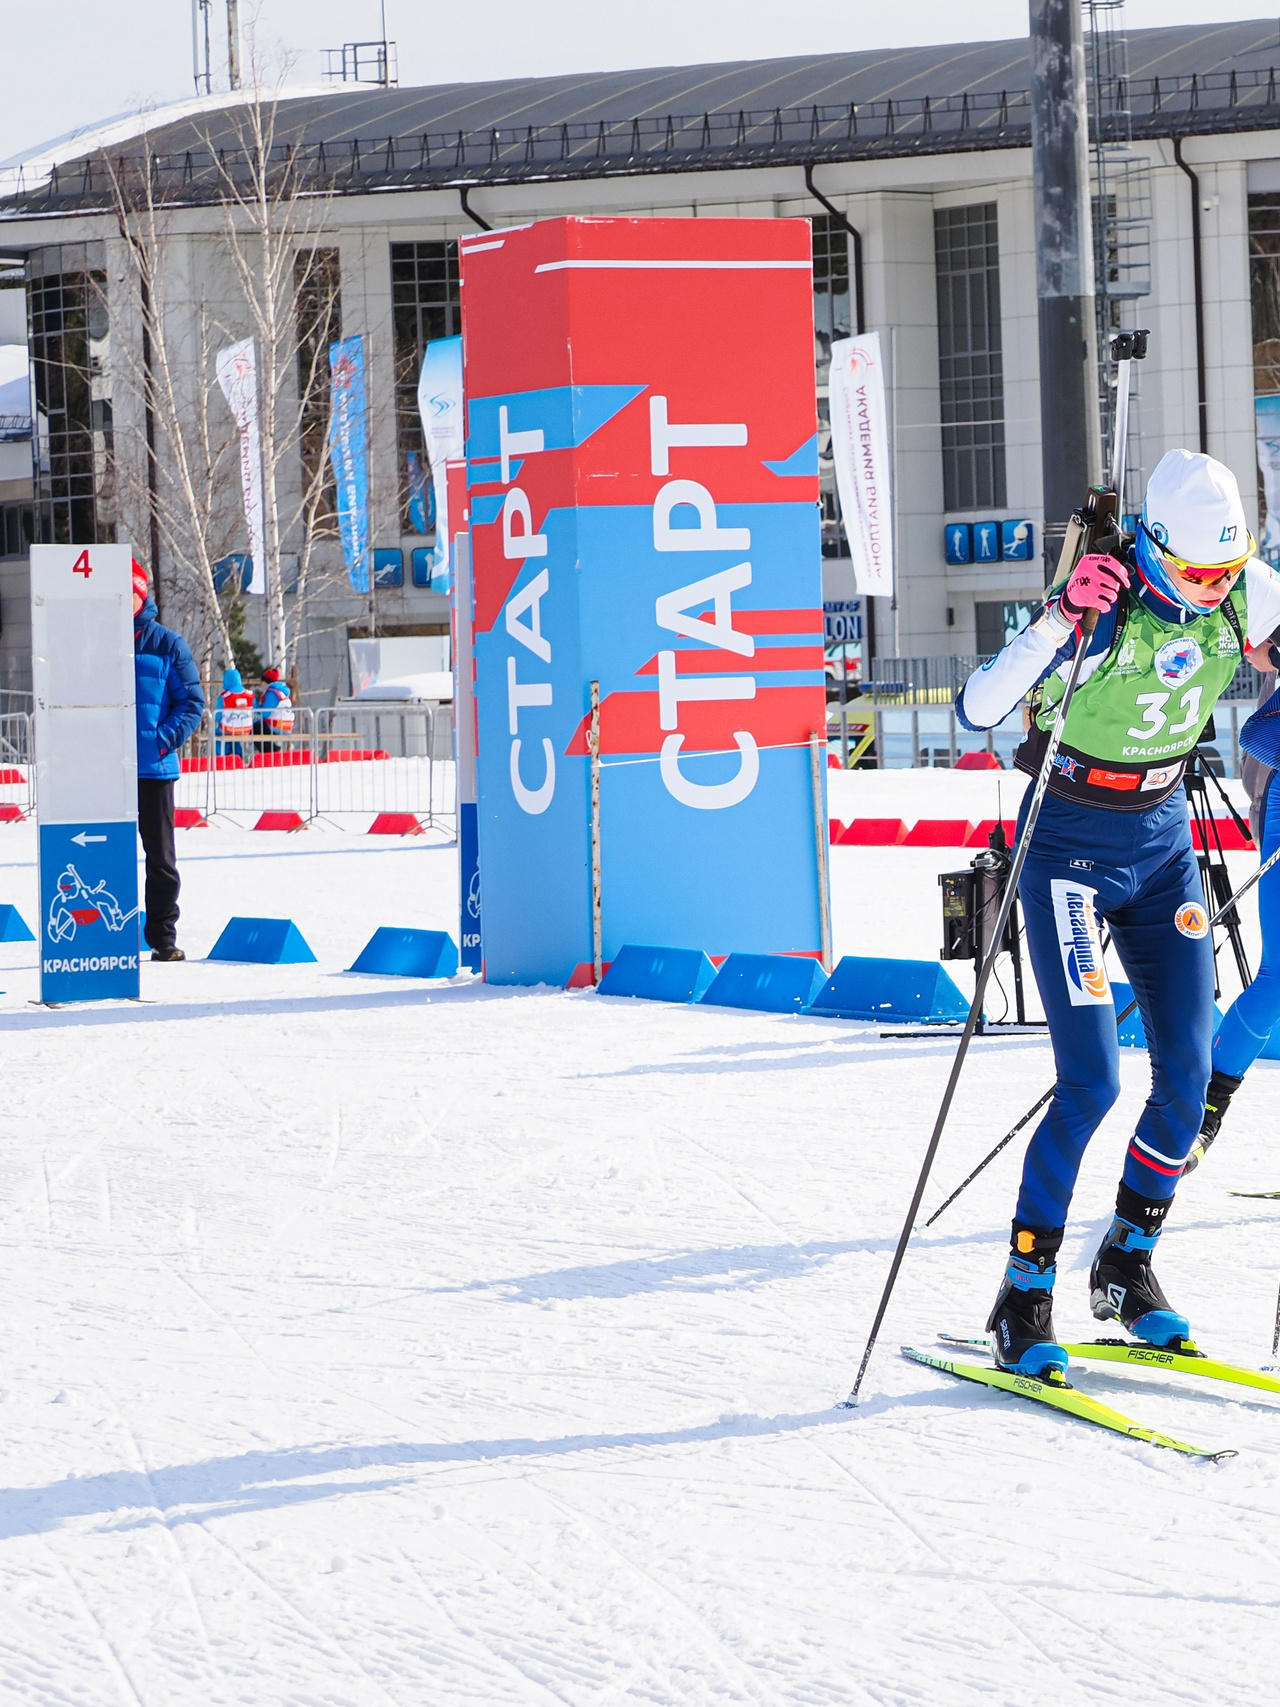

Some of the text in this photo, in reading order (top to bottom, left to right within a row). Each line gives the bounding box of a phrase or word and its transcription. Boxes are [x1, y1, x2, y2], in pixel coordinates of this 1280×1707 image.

[72, 549, 93, 579] 4
[499, 404, 556, 816] СТАРТ
[648, 394, 760, 811] СТАРТ
[1126, 685, 1204, 741] 31
[1121, 734, 1196, 757] КРАСНОЯРСК
[42, 953, 139, 974] КРАСНОЯРСК
[1144, 1206, 1165, 1217] 181
[1126, 1349, 1175, 1365] FISCHER
[1012, 1377, 1043, 1395] FISCHER
